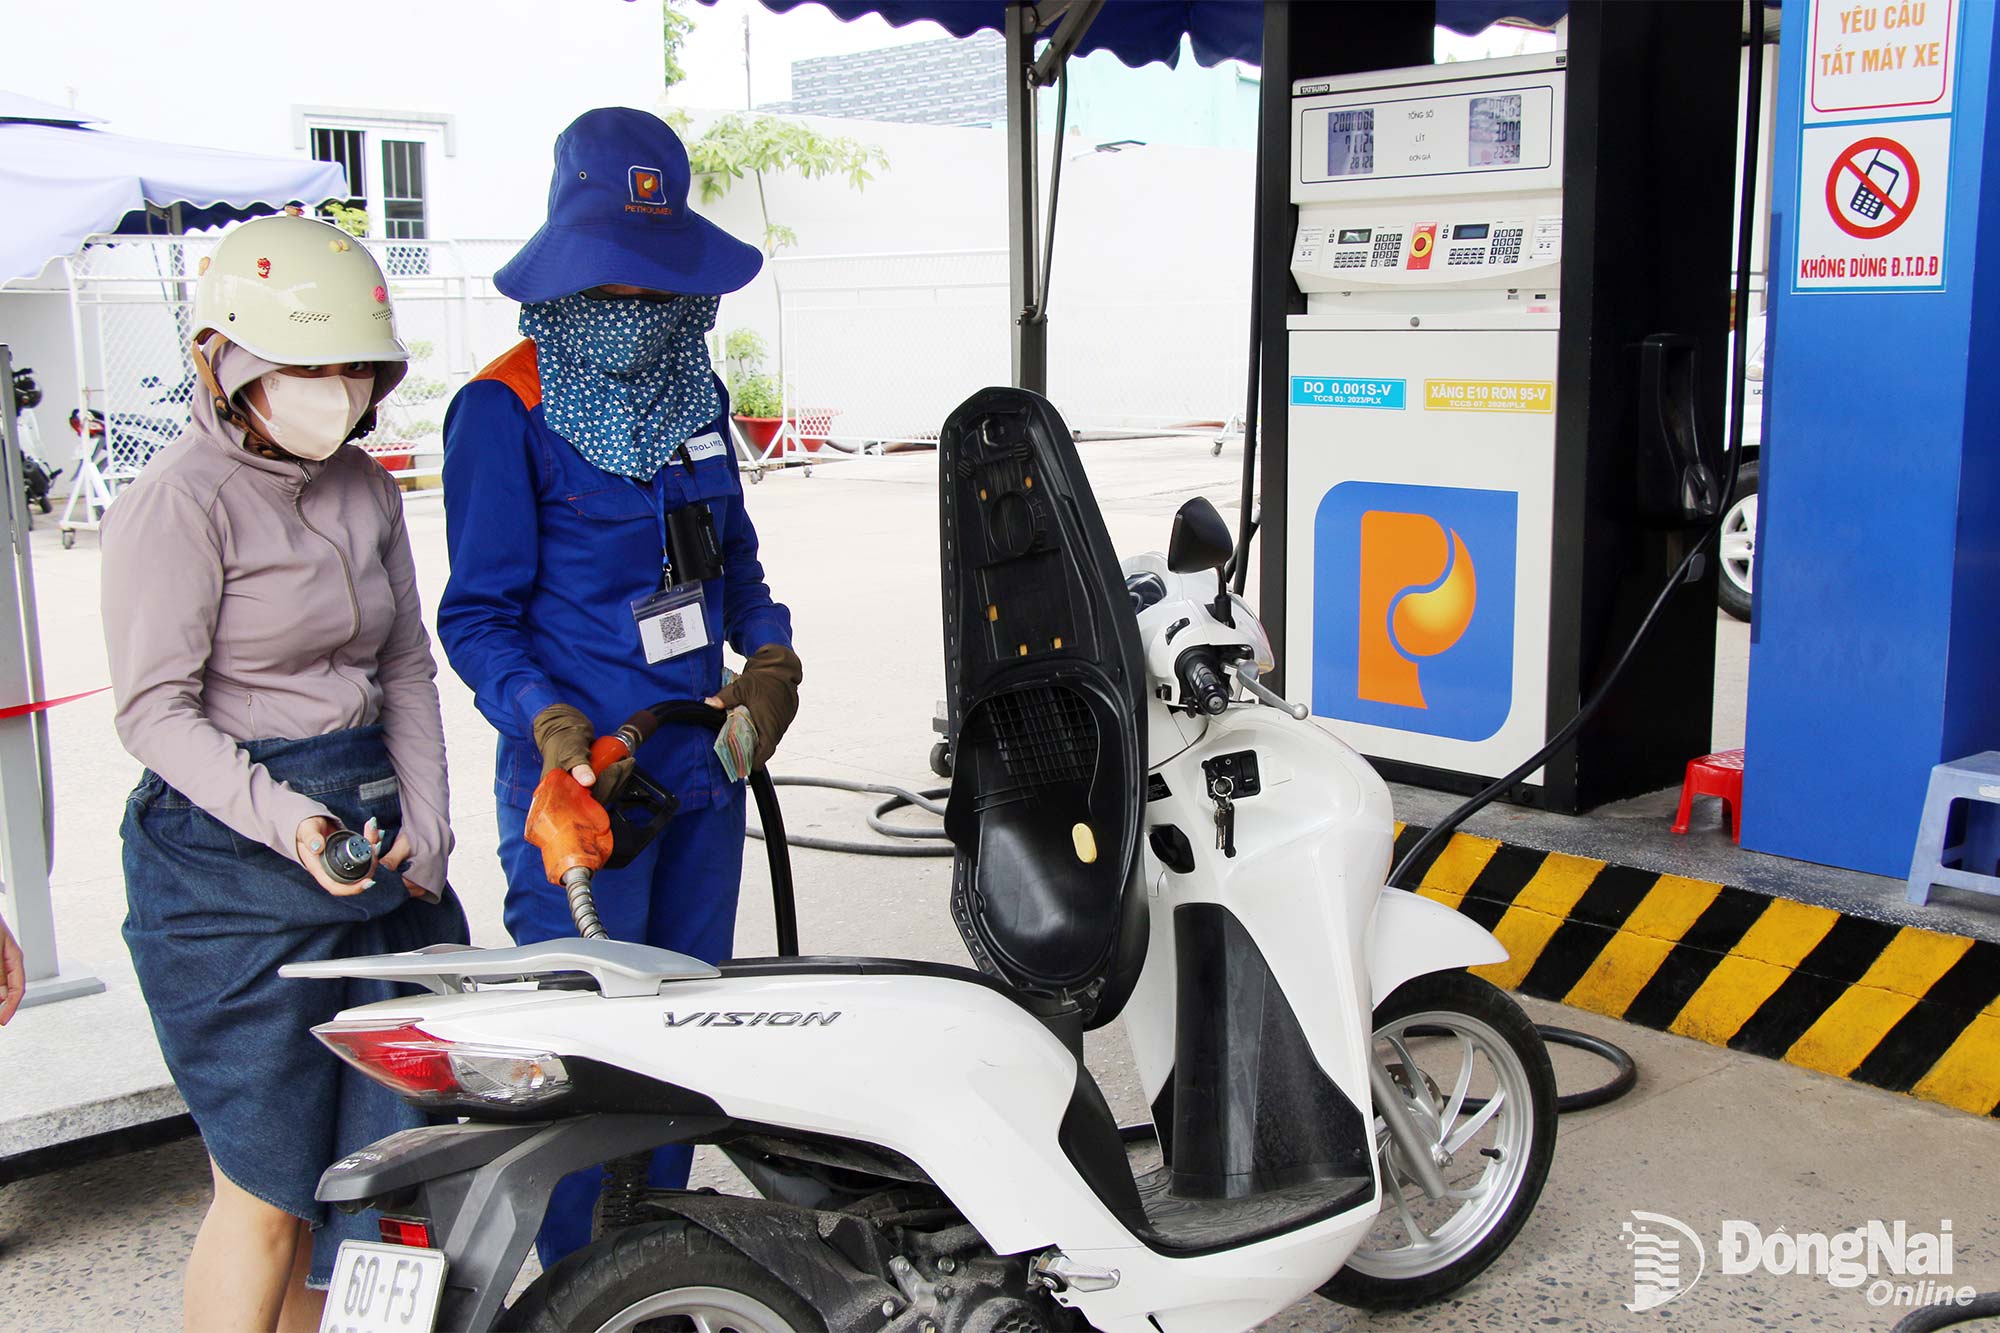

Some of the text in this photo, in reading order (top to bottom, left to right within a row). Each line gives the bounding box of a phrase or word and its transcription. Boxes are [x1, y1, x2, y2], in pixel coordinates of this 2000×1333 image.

[1840, 5, 1877, 34] YÊU
[1821, 42, 1940, 76] TẤT MÁY XE
[1801, 255, 1845, 278] KHÔNG
[1891, 256, 1938, 277] Đ.T.D.Đ
[1303, 382, 1392, 396] DO 0.001S-V
[1431, 384, 1547, 400] XĂNG E10 RON 95-V
[663, 1011, 842, 1027] VISION
